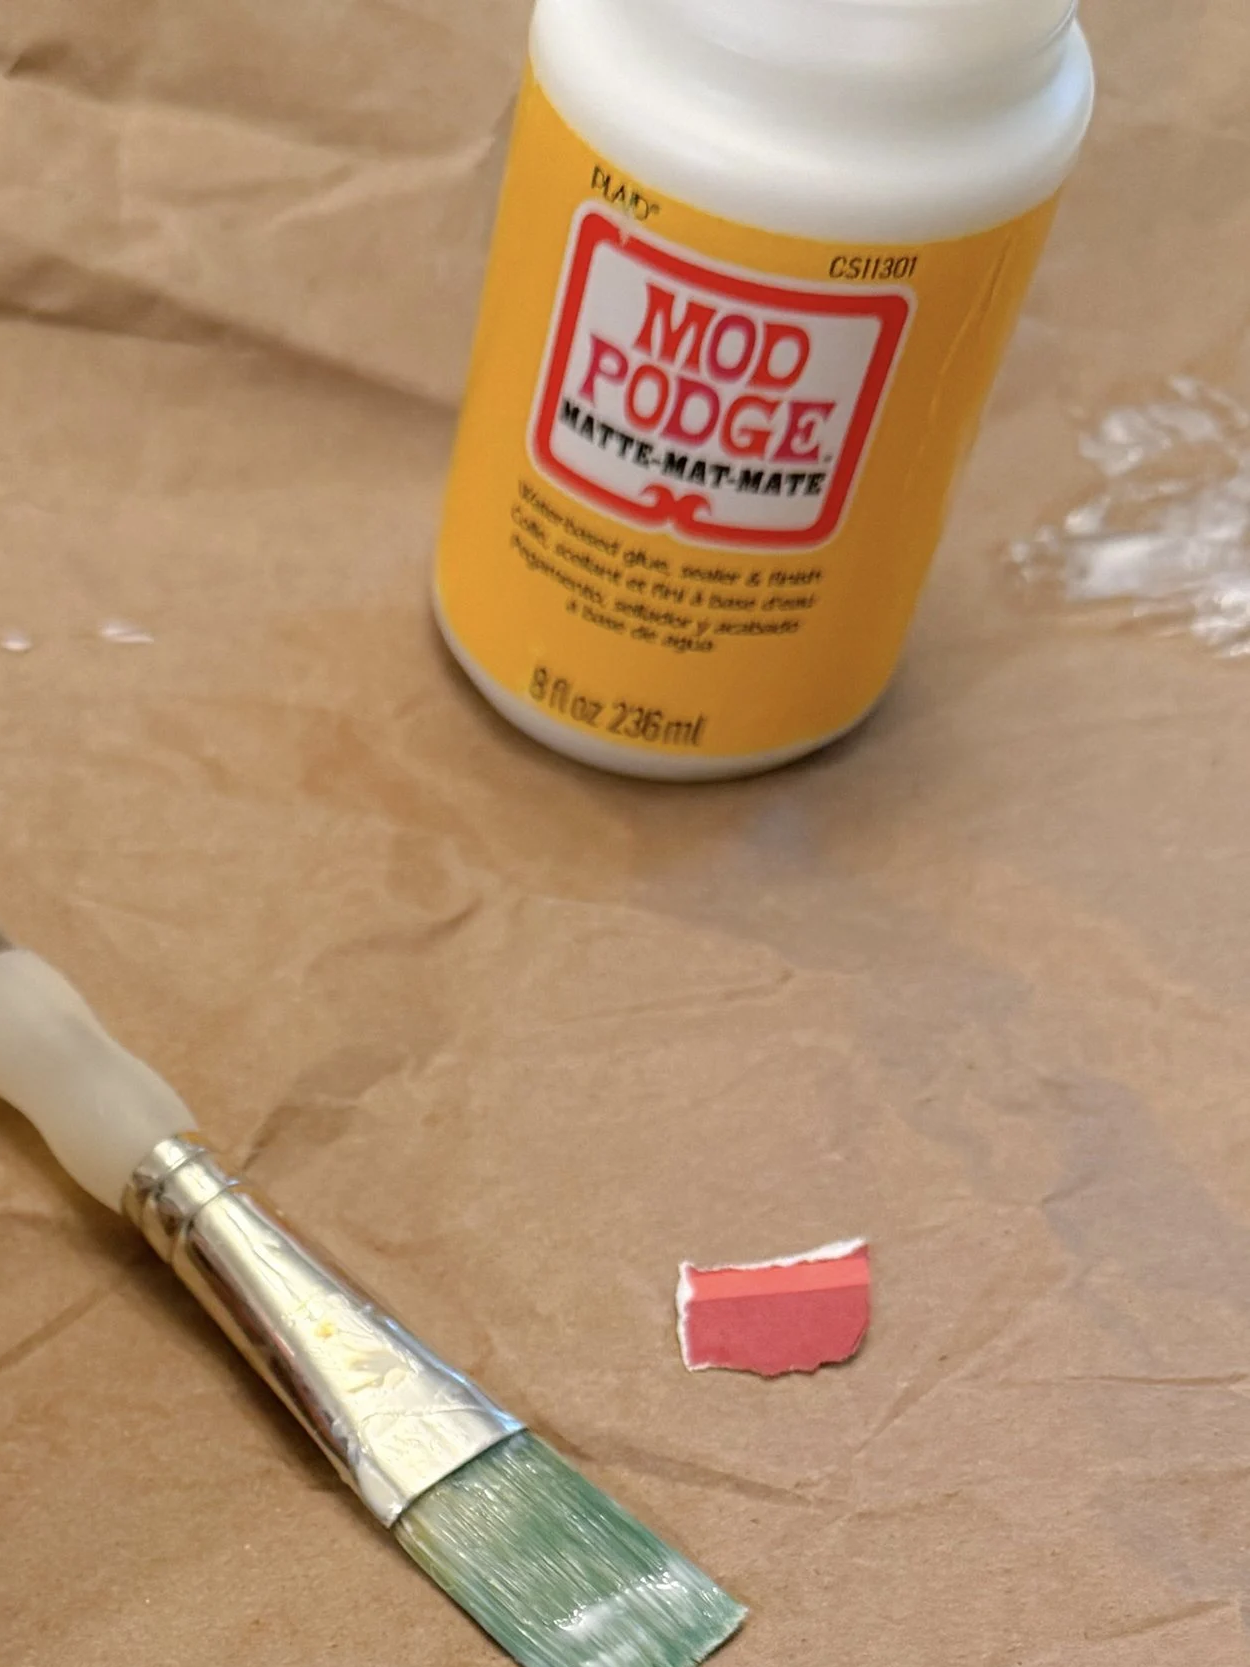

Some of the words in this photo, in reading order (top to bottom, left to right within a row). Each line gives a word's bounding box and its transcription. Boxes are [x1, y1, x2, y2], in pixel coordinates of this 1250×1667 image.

[829, 254, 919, 280] CS11301
[632, 282, 811, 391] MOD
[558, 397, 827, 498] MATTE-MAT-MATE
[579, 332, 837, 465] PODGE
[529, 665, 549, 702] 8
